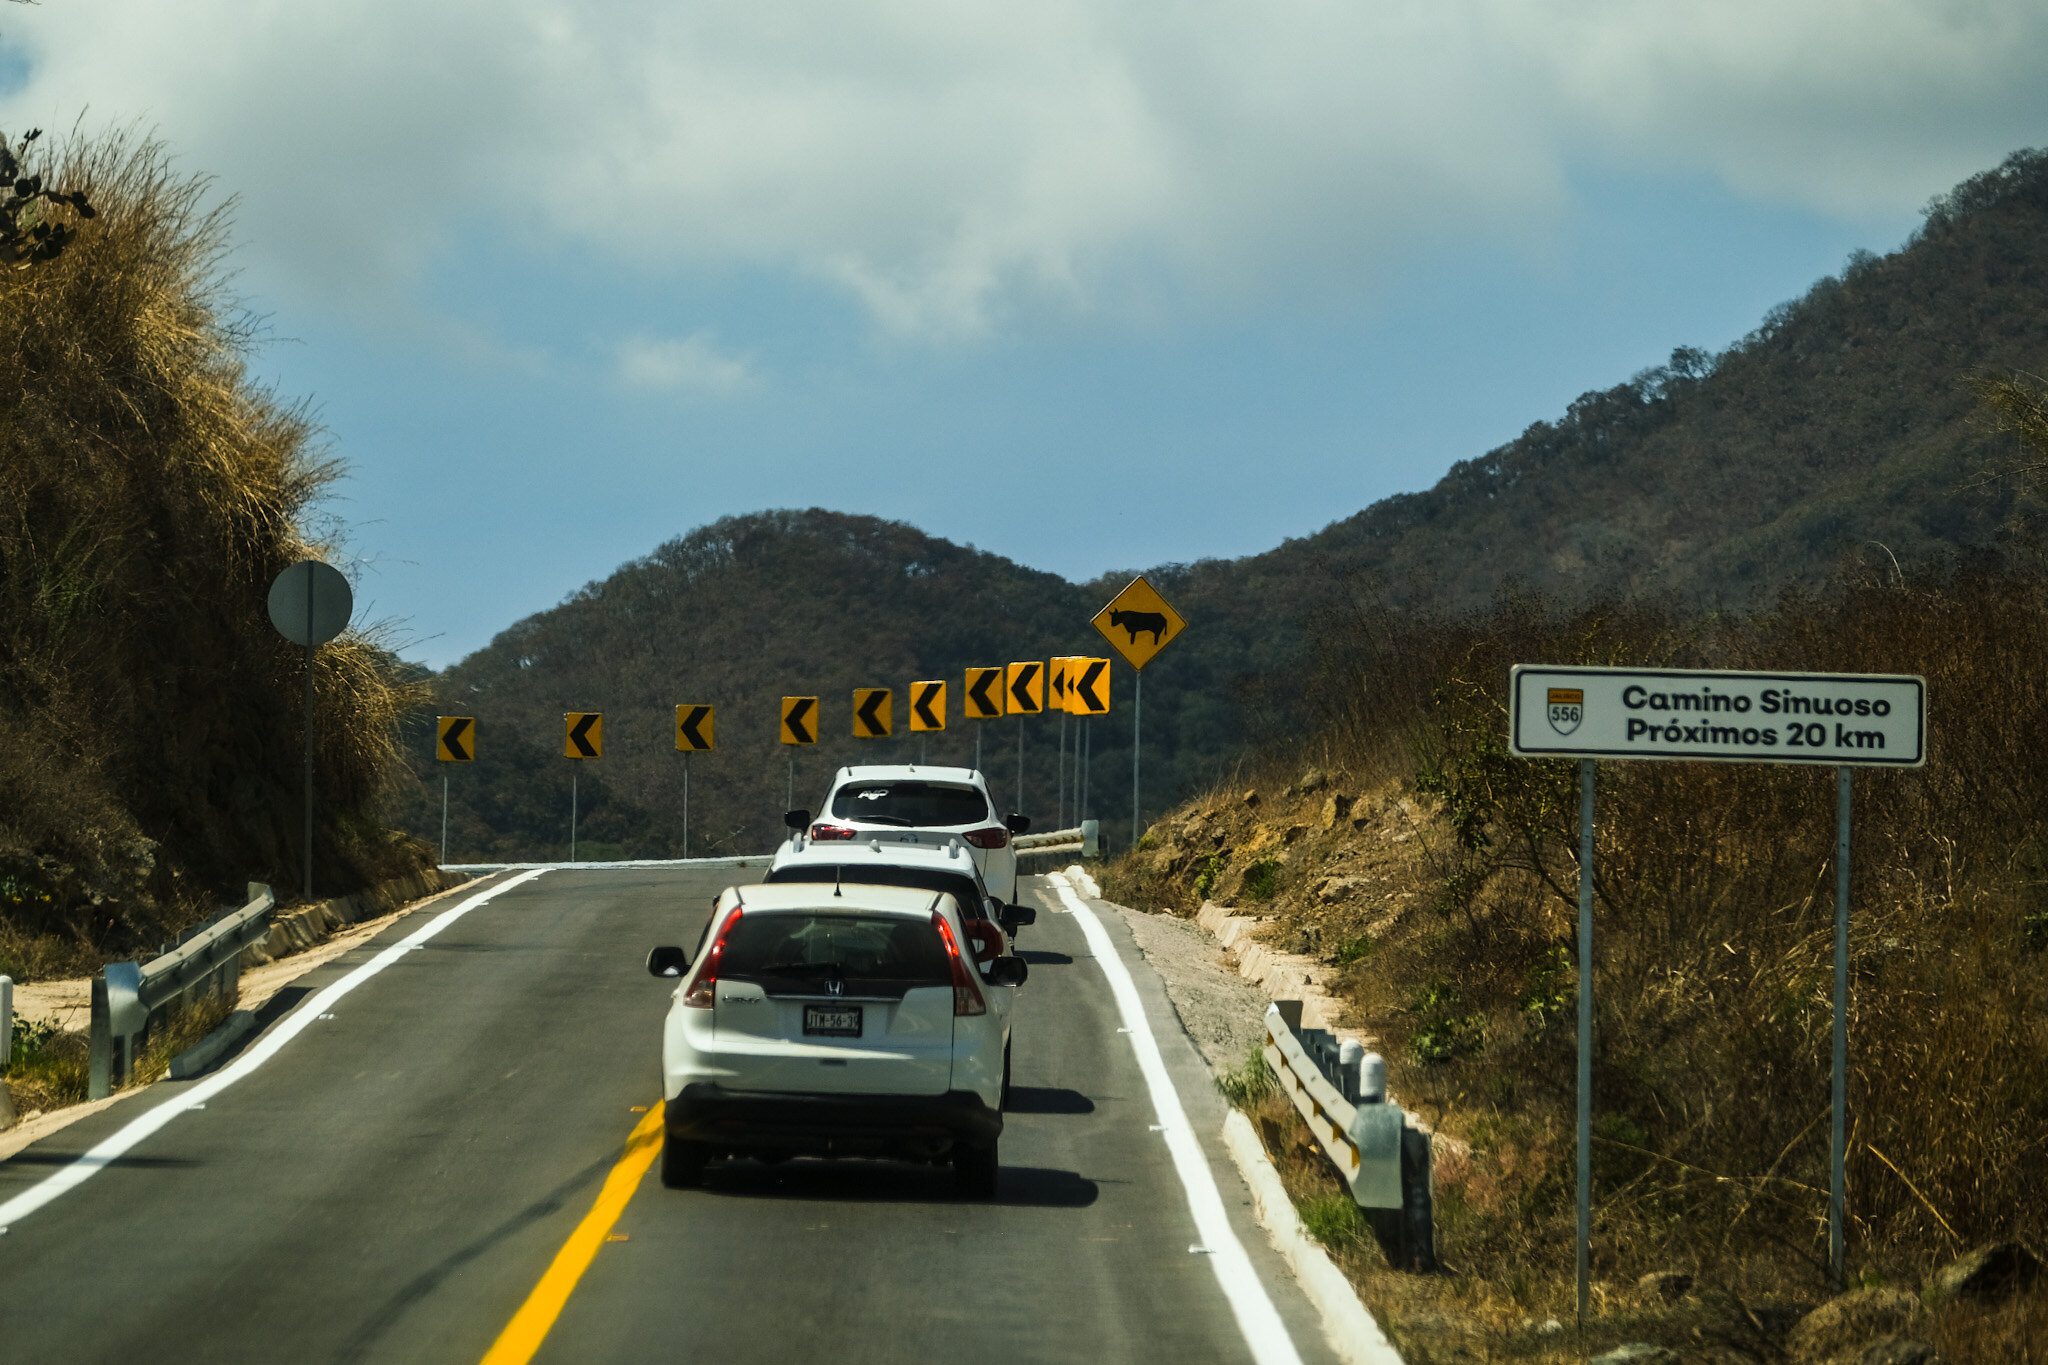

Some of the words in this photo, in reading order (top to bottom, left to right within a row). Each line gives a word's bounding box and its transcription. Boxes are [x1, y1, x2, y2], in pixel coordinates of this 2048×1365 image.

[1552, 706, 1579, 722] 556
[1623, 685, 1752, 713] Camino
[1760, 689, 1891, 717] Sinuoso
[1627, 718, 1778, 746] Próximos
[1786, 722, 1826, 747] 20
[1835, 723, 1885, 748] km
